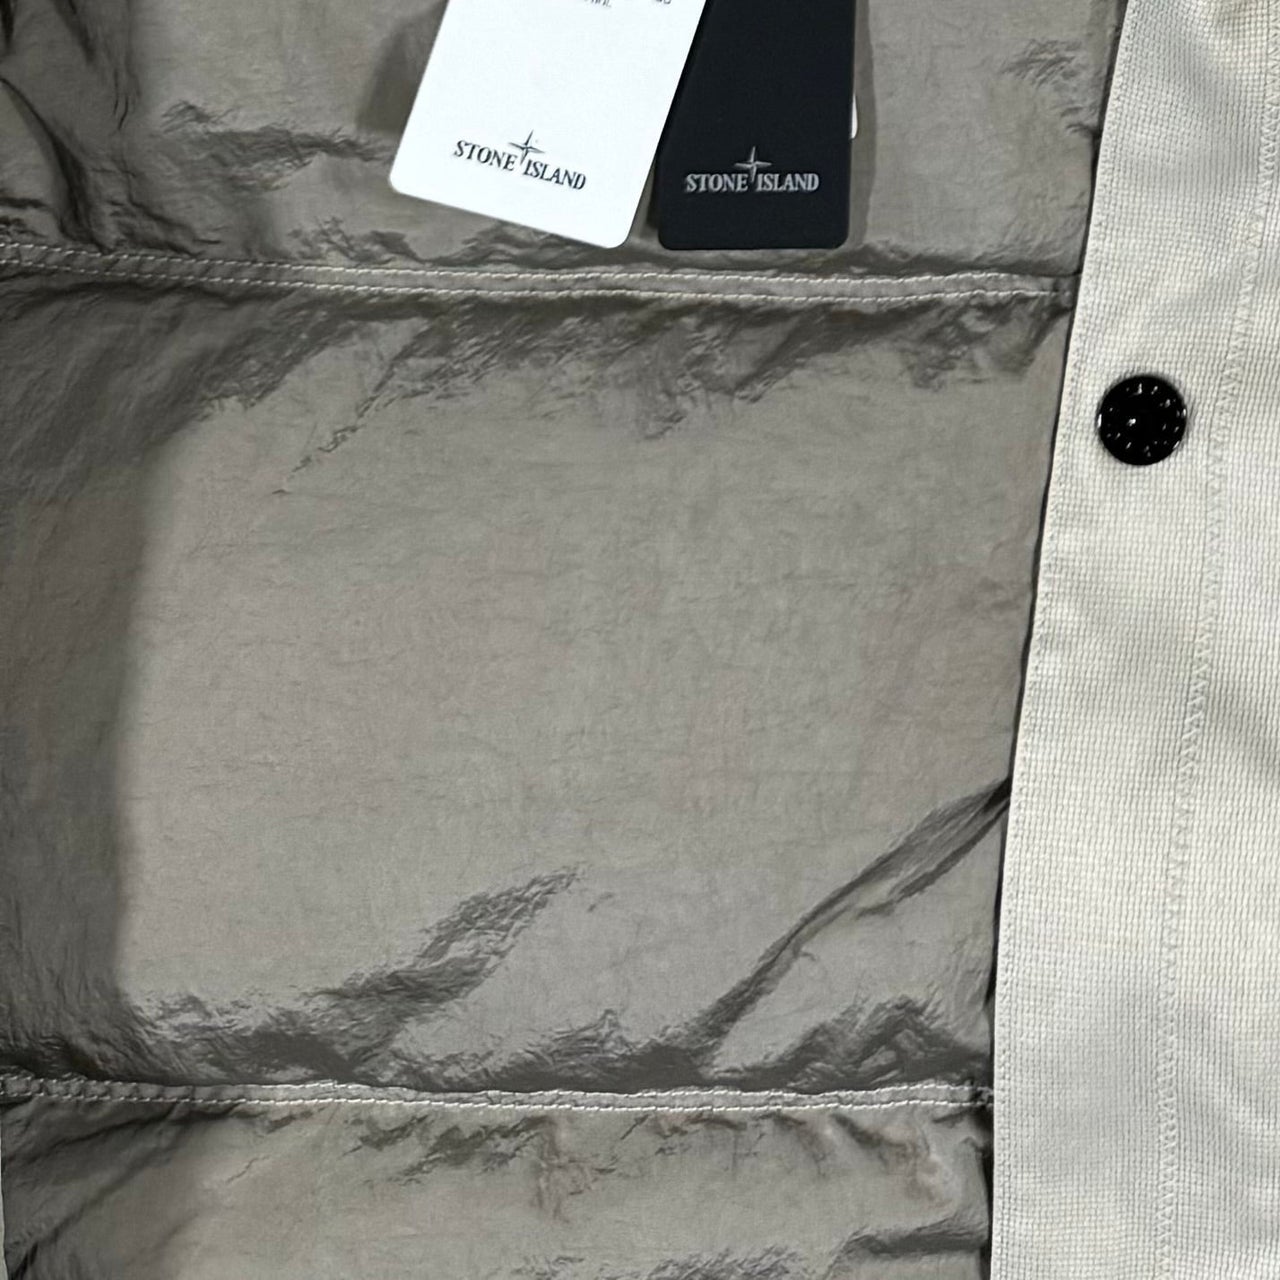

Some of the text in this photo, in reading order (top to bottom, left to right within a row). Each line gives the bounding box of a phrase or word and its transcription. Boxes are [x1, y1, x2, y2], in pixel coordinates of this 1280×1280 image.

[454, 140, 586, 191] STONE ISLAND
[685, 173, 820, 193] STONE ISLAND
